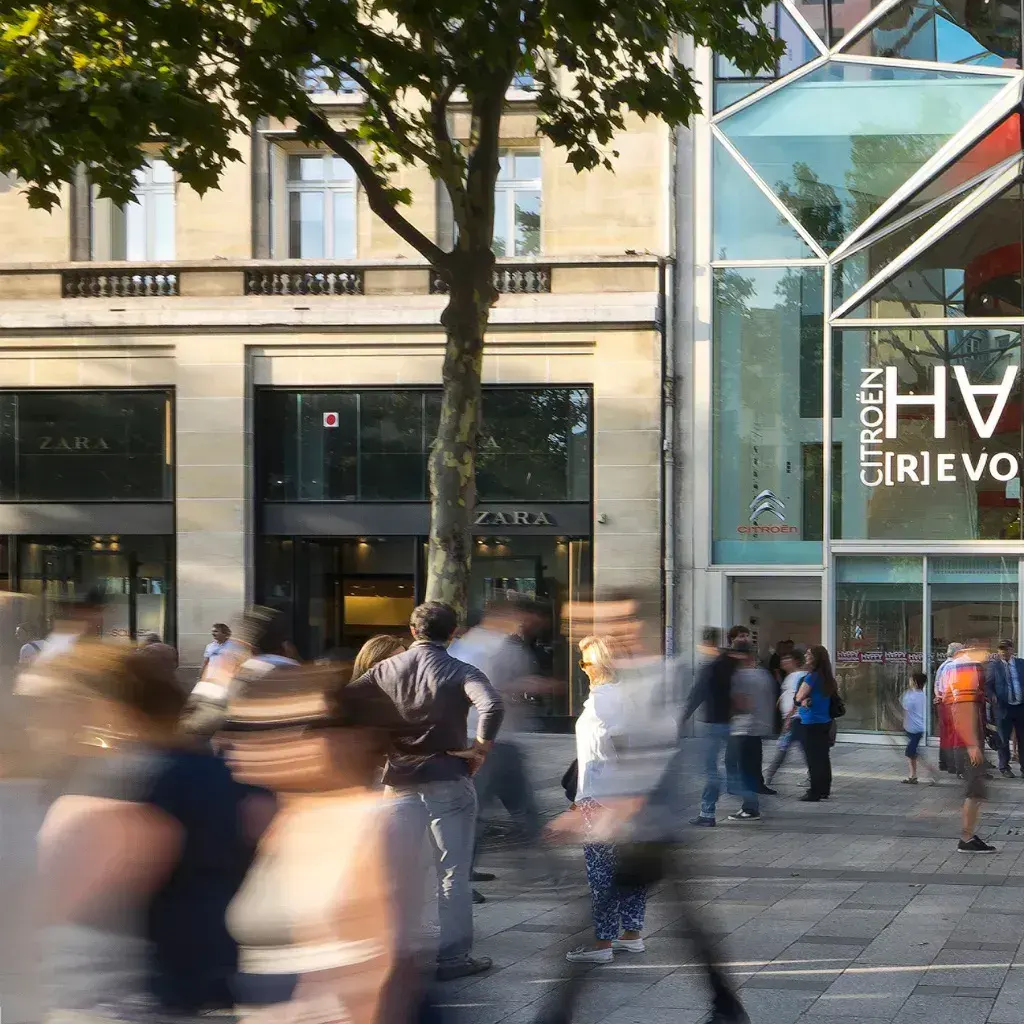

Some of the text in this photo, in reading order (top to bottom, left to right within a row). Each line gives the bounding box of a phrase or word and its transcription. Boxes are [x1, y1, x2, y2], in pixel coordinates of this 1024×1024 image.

[857, 367, 884, 487] CITROËN
[40, 436, 110, 450] ZARA
[474, 511, 552, 525] ZARA
